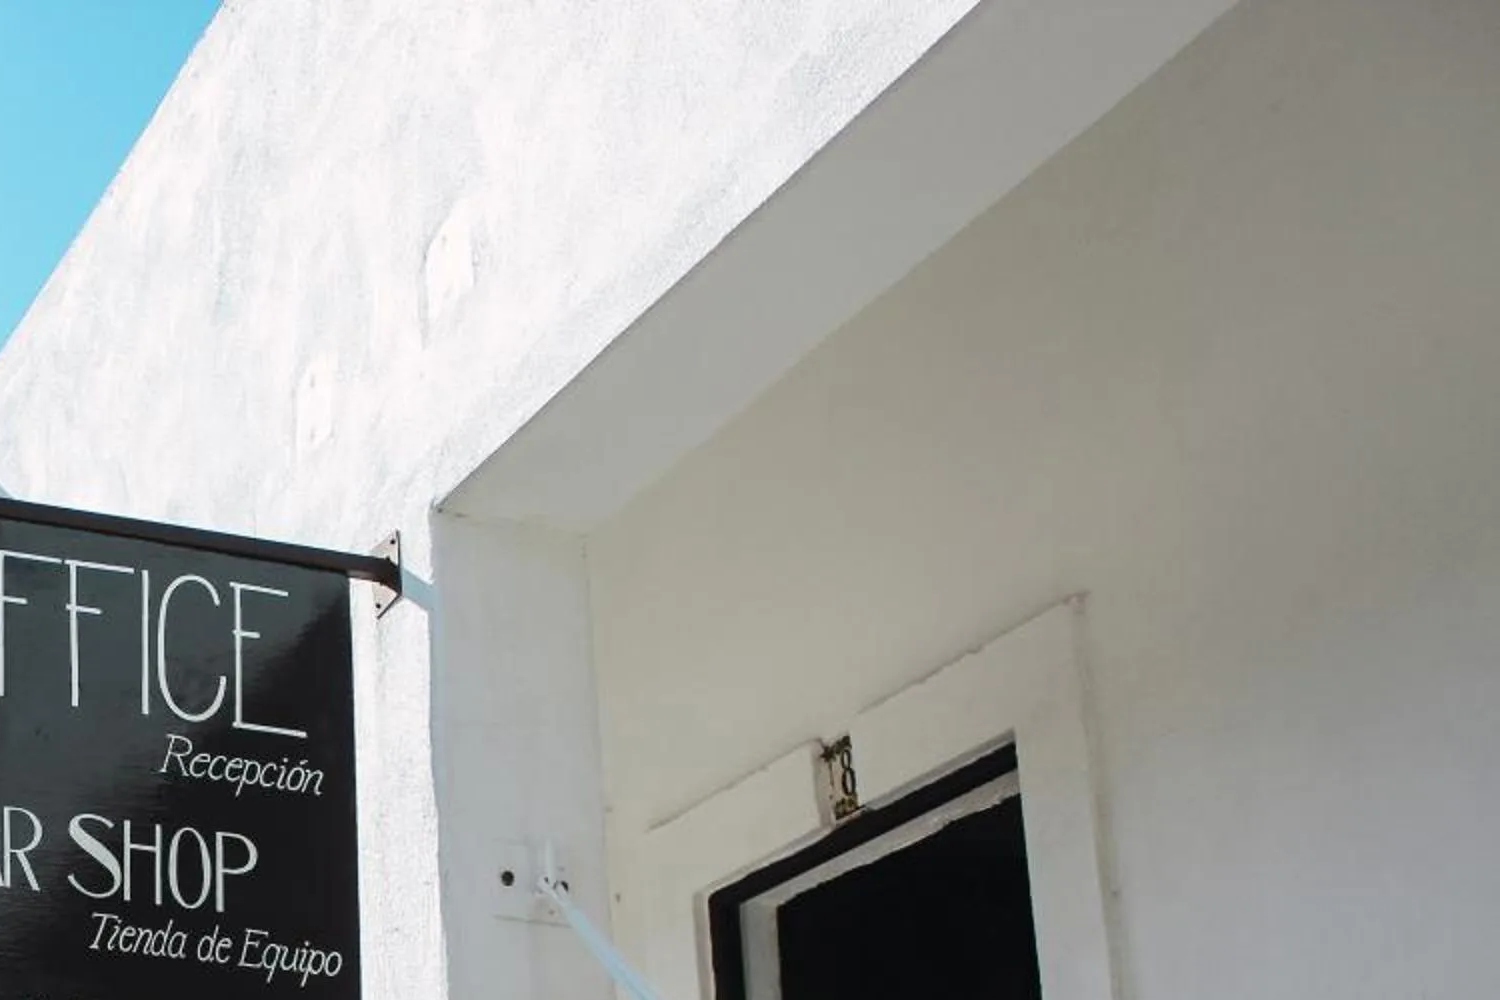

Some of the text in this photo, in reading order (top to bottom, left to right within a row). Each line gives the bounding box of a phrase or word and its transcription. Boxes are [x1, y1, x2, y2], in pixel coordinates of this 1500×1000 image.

[158, 733, 324, 797] Recepción
[67, 813, 259, 913] SHOP
[88, 911, 343, 988] Tienda de Equipo
